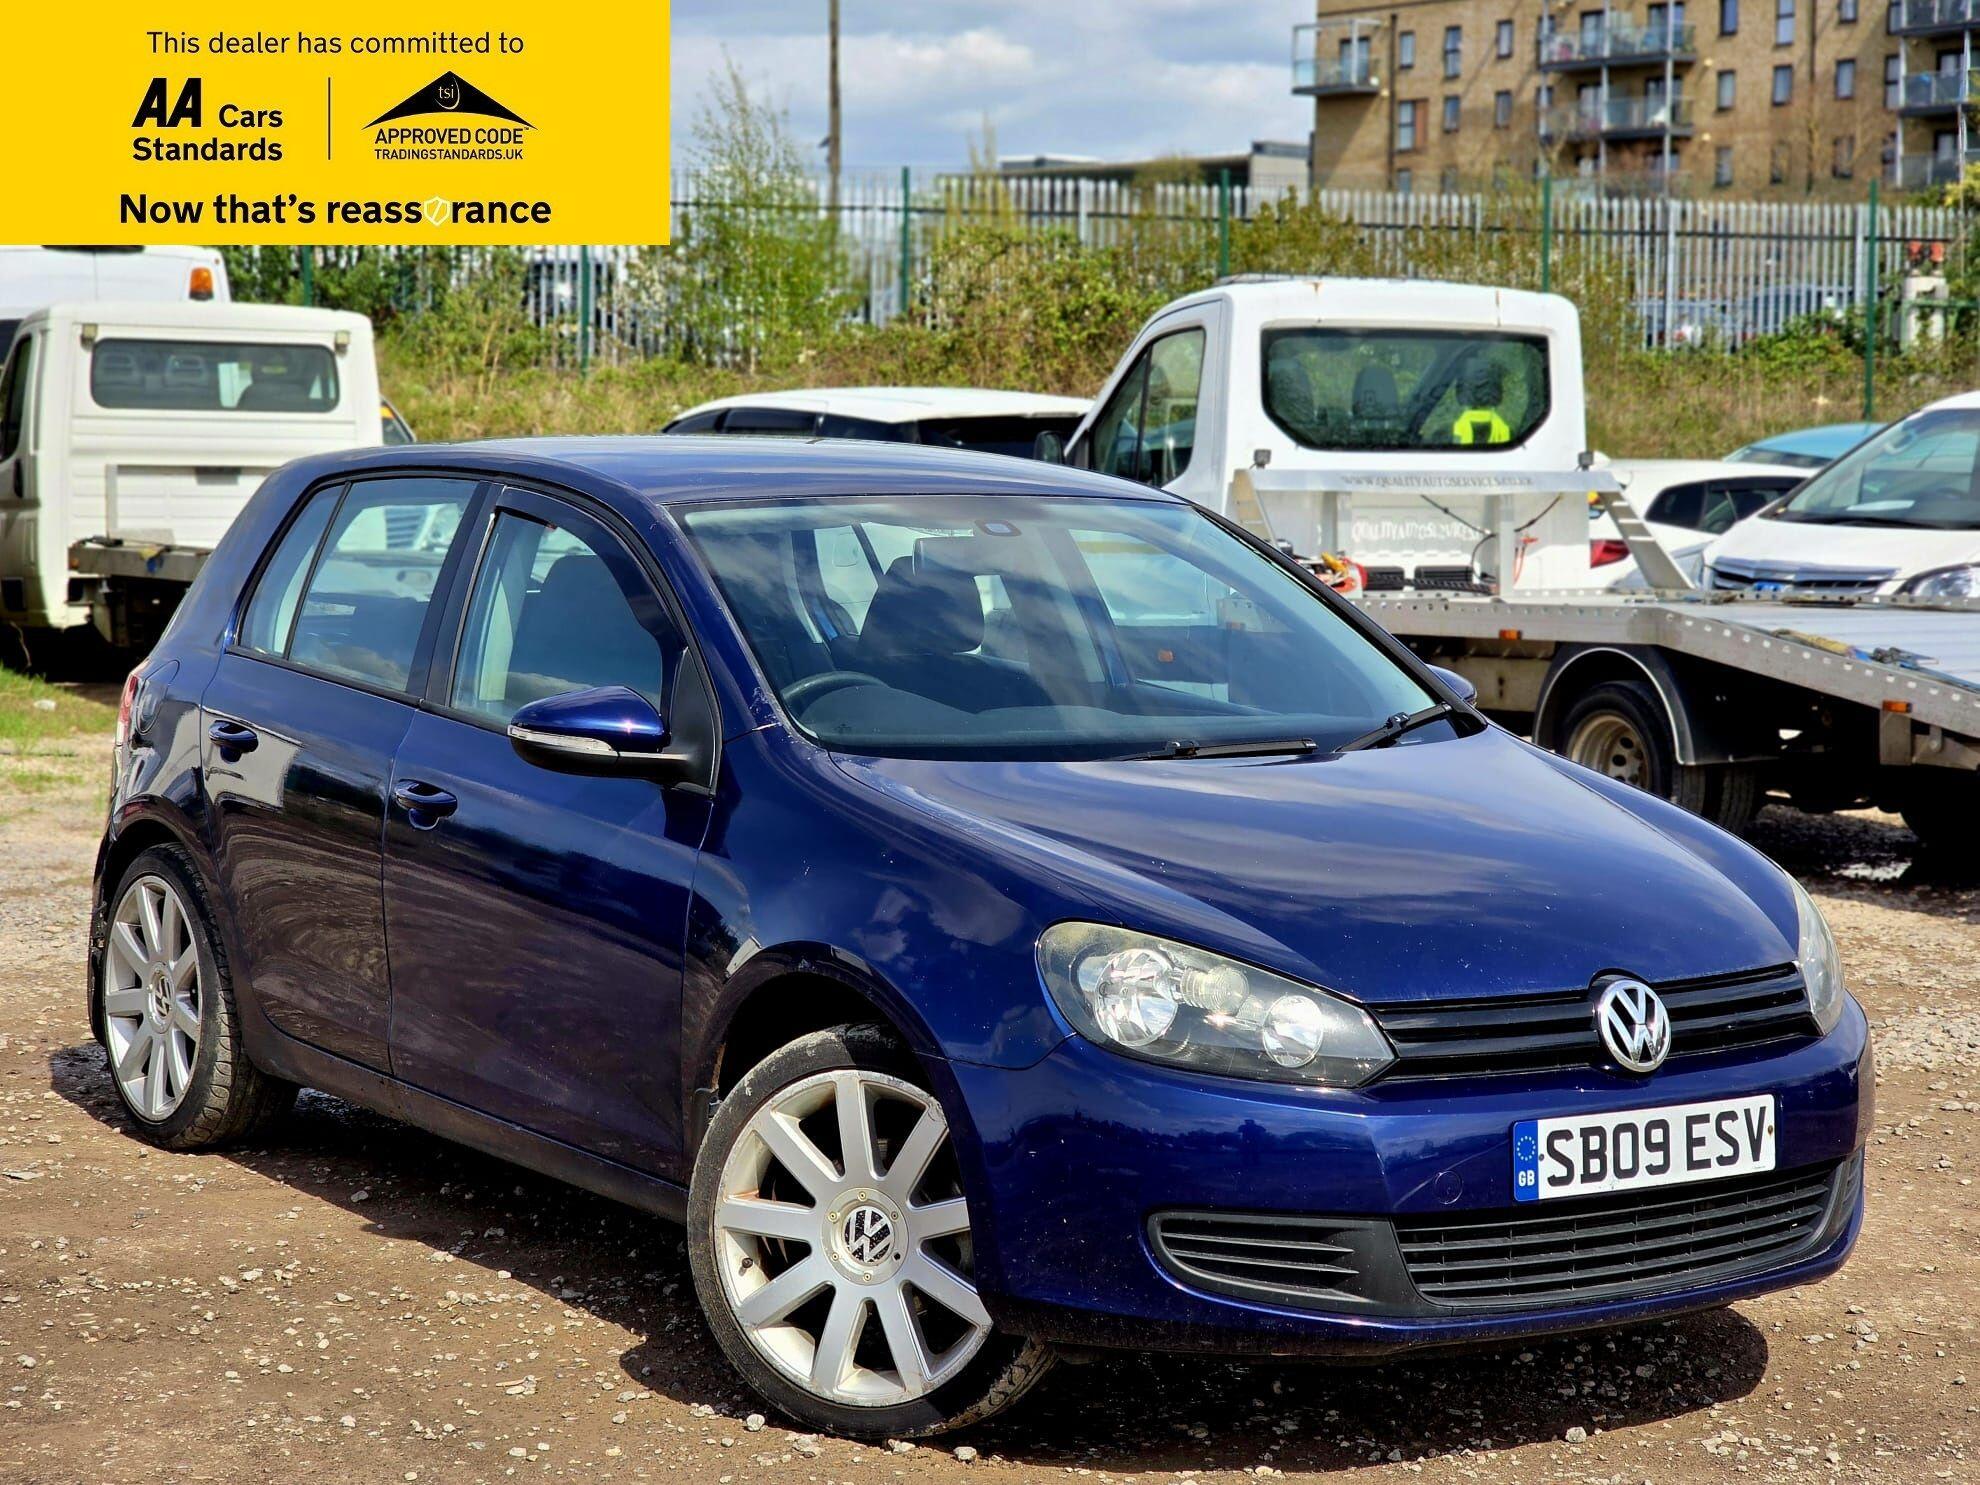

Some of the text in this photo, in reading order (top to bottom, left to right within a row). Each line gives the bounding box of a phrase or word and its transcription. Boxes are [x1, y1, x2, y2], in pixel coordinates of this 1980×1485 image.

[1600, 978, 1671, 1072] VW
[1518, 1169, 1535, 1187] GB
[1546, 1105, 1767, 1188] SB09 ESV
